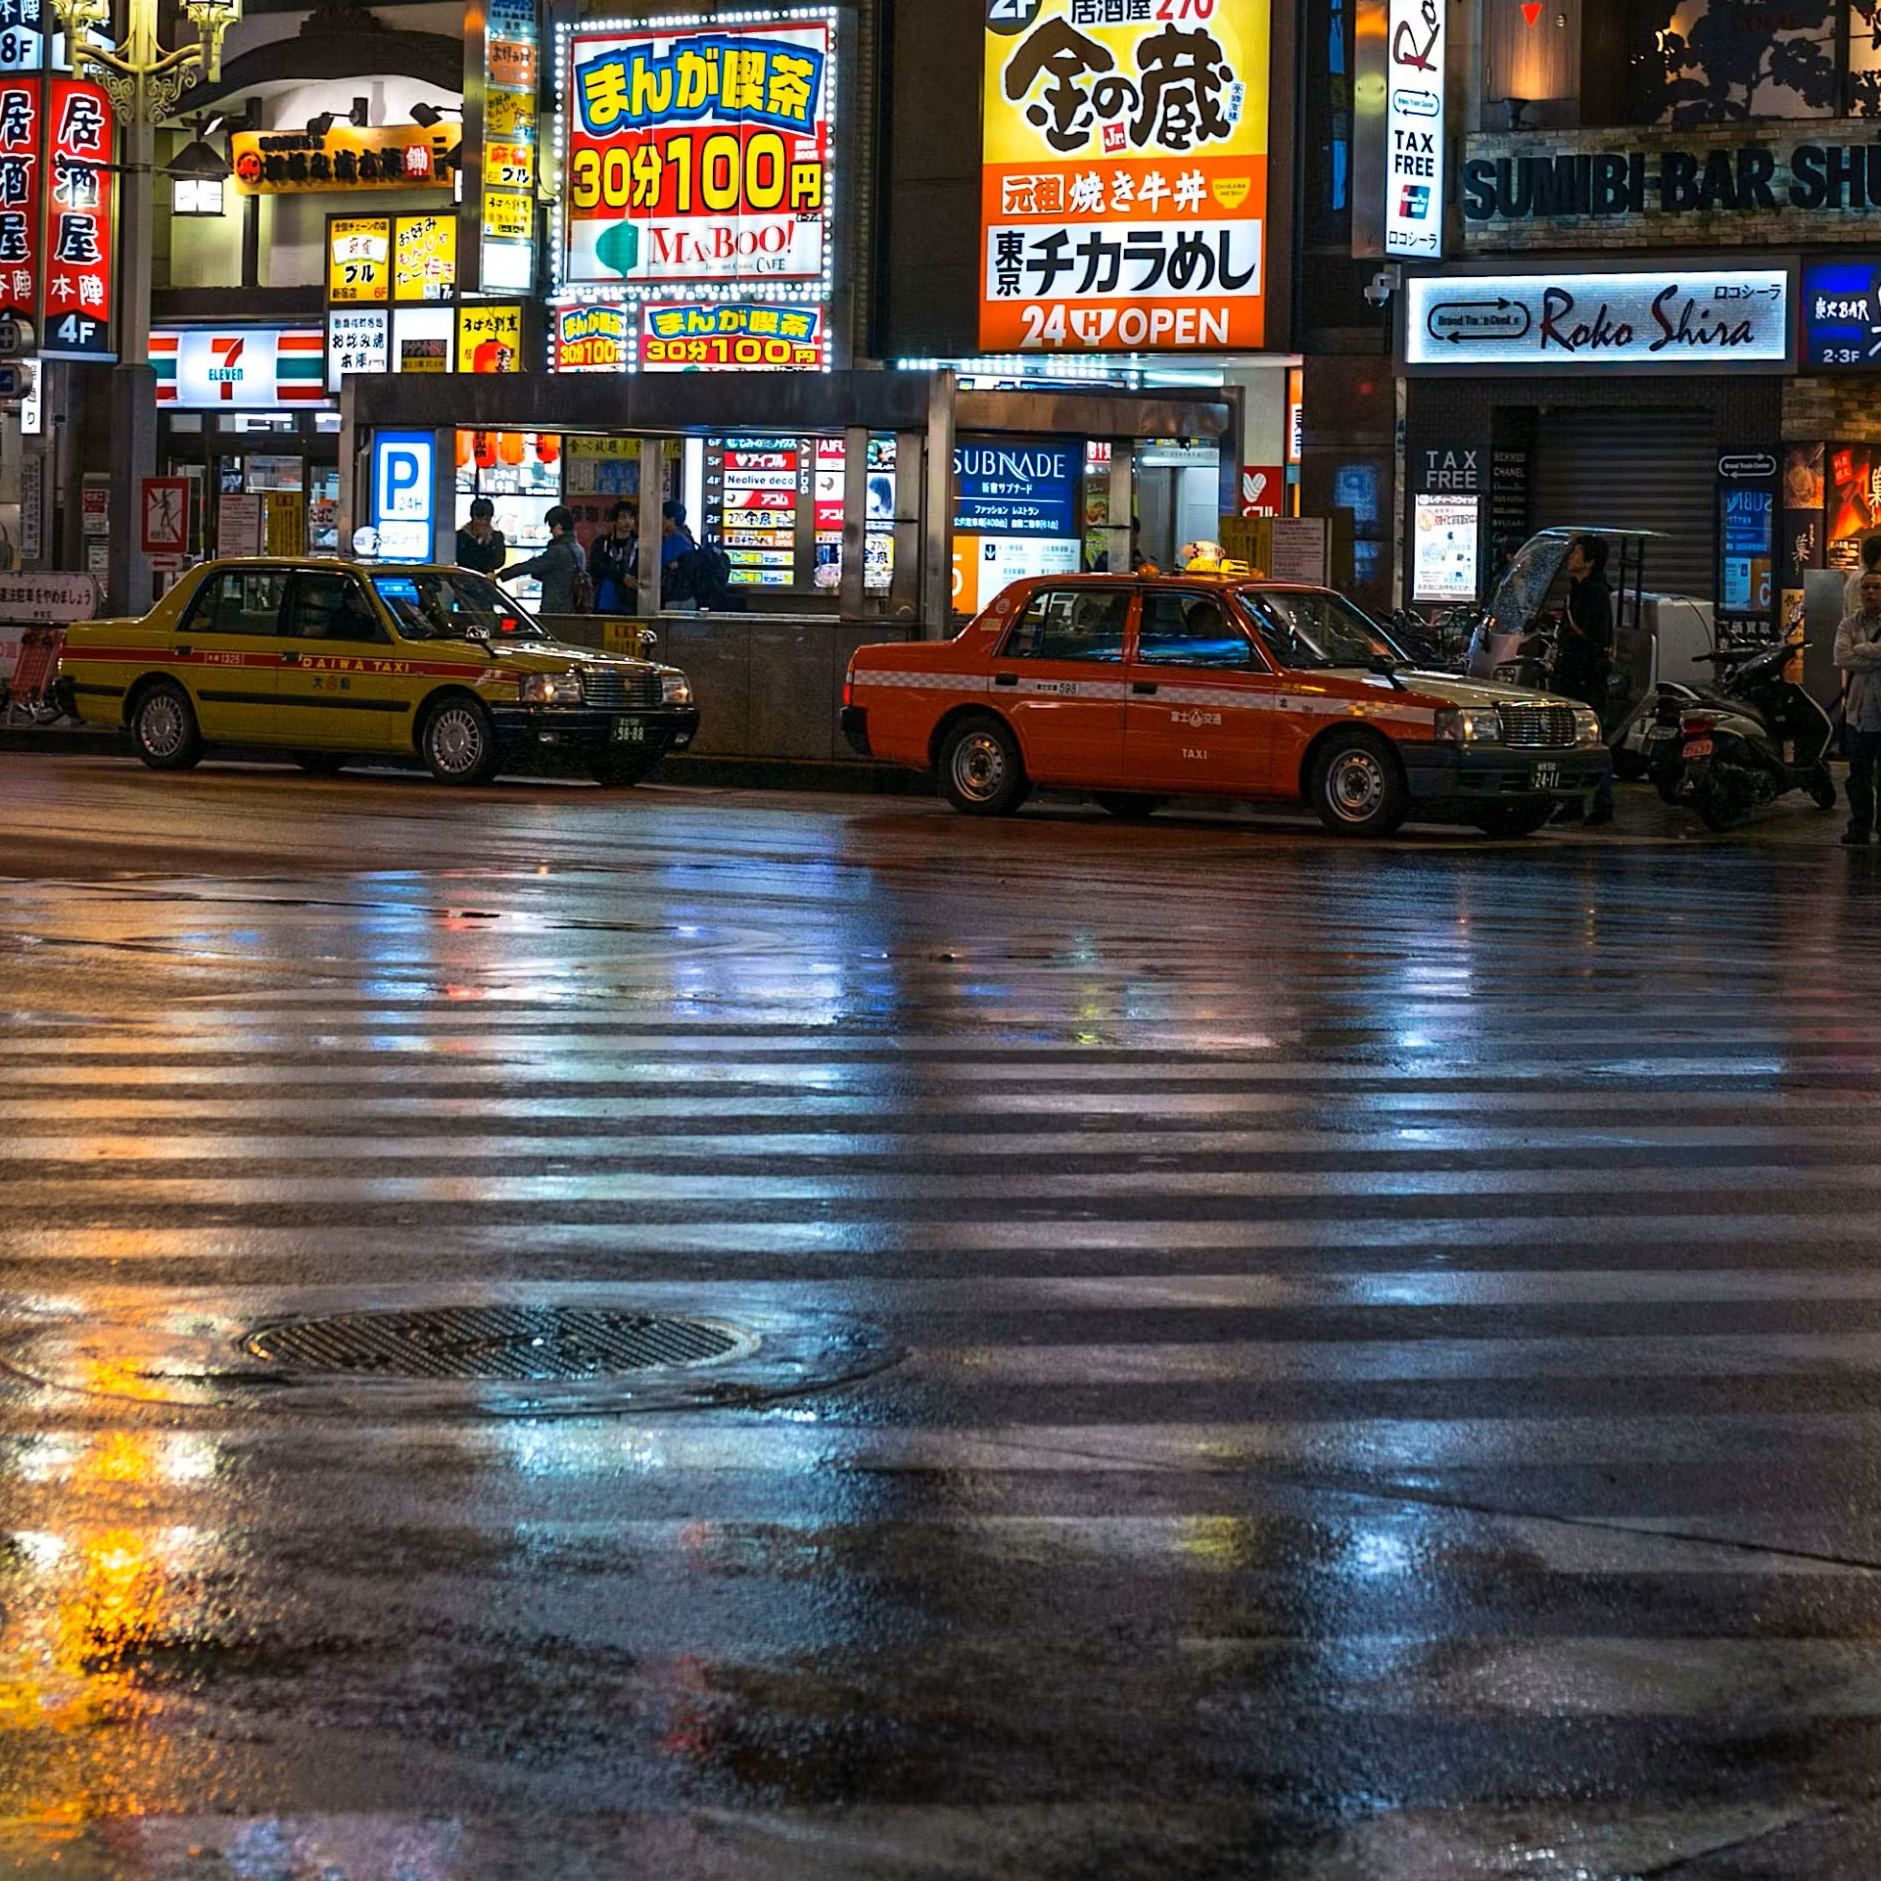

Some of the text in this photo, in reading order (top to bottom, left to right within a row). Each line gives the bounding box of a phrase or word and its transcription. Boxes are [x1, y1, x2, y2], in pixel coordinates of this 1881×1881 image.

[1, 30, 33, 64] 8F
[583, 43, 816, 120] まんが喫茶
[1002, 15, 1234, 152] 金の蔵
[1394, 130, 1435, 155] TAX
[571, 132, 824, 212] 30分100円
[1394, 154, 1435, 178] FREE
[1003, 170, 1208, 214] 元祖 焼き牛丼
[344, 264, 376, 284] ブル
[51, 272, 104, 306] 本陣
[1713, 282, 1783, 301] ロコシーラ
[57, 316, 96, 344] 4F
[655, 309, 811, 339] まんが喫茶
[1539, 282, 1755, 353] Roko Shira
[646, 339, 817, 365] 30分100円
[1426, 450, 1478, 469] TAX
[1492, 466, 1525, 478] CHANEL
[727, 473, 795, 486] Neolive deco
[982, 482, 1035, 496] 新宿サブナード
[1426, 470, 1478, 490] FREE
[302, 657, 410, 673] DAIWA TAXI
[1181, 747, 1208, 761] TAXI
